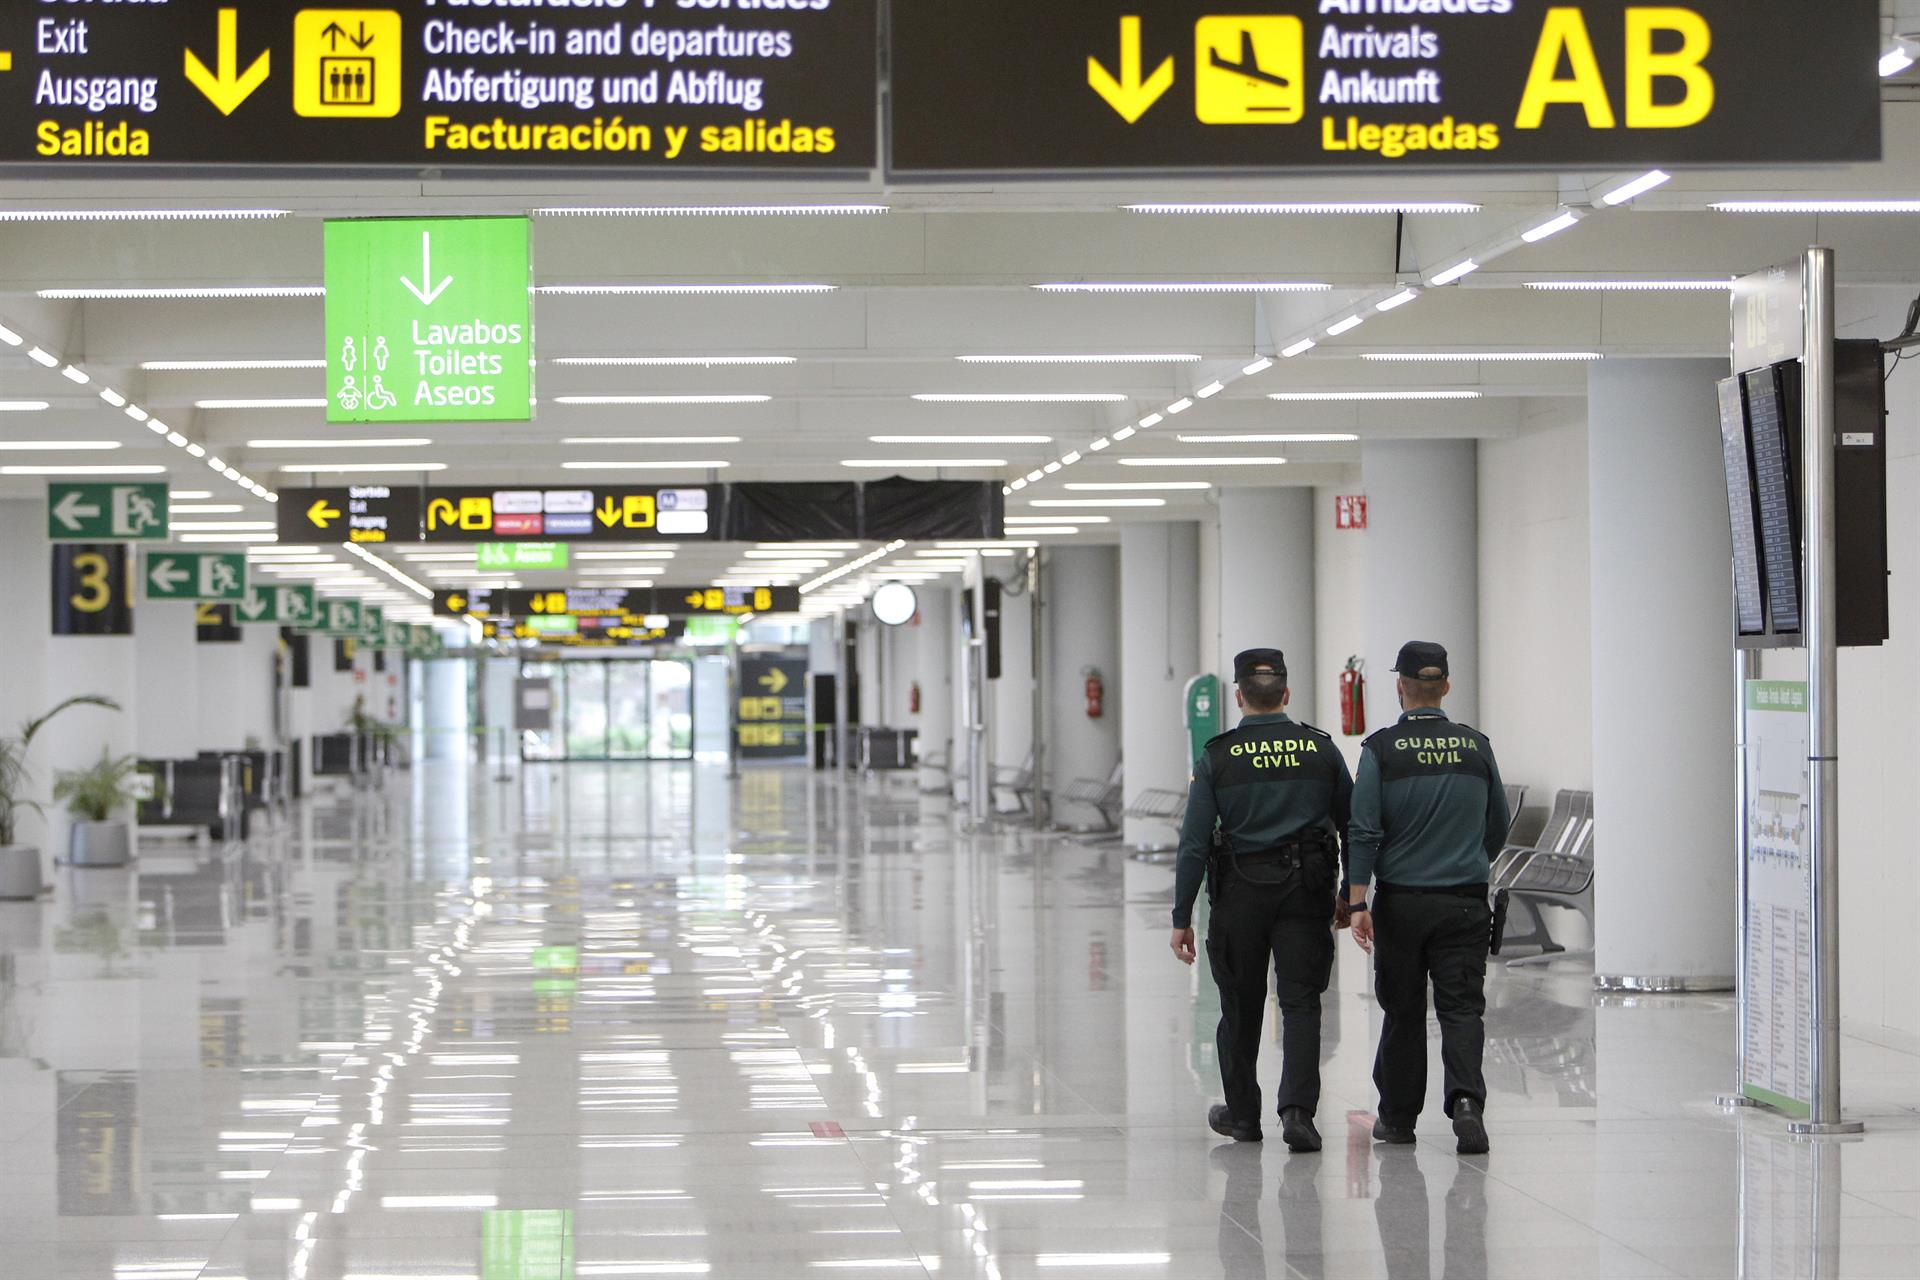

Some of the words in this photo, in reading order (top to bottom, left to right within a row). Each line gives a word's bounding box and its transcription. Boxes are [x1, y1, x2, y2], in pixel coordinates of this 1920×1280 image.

[37, 18, 88, 54] Exit
[424, 20, 556, 55] Check-in
[565, 22, 621, 56] and
[630, 22, 792, 62] departures
[1319, 24, 1438, 58] Arrivals
[36, 70, 157, 112] Ausgang
[423, 68, 594, 109] Abfertigung
[602, 70, 658, 104] und
[666, 70, 763, 111] Abflug
[1319, 69, 1440, 103] Ankunft
[36, 120, 149, 156] Salida
[425, 116, 651, 151] Facturación
[664, 126, 688, 158] y
[700, 119, 835, 153] salidas
[1322, 116, 1499, 157] Llegadas
[412, 318, 522, 345] Lavabos
[413, 349, 503, 376] Toilets
[413, 380, 496, 406] Aseos
[71, 553, 111, 612] 3
[1230, 739, 1318, 757] GUARDIA
[1394, 736, 1479, 752] GUARDIA
[1416, 749, 1462, 765] CIVIL
[1252, 755, 1300, 769] CIVIL
